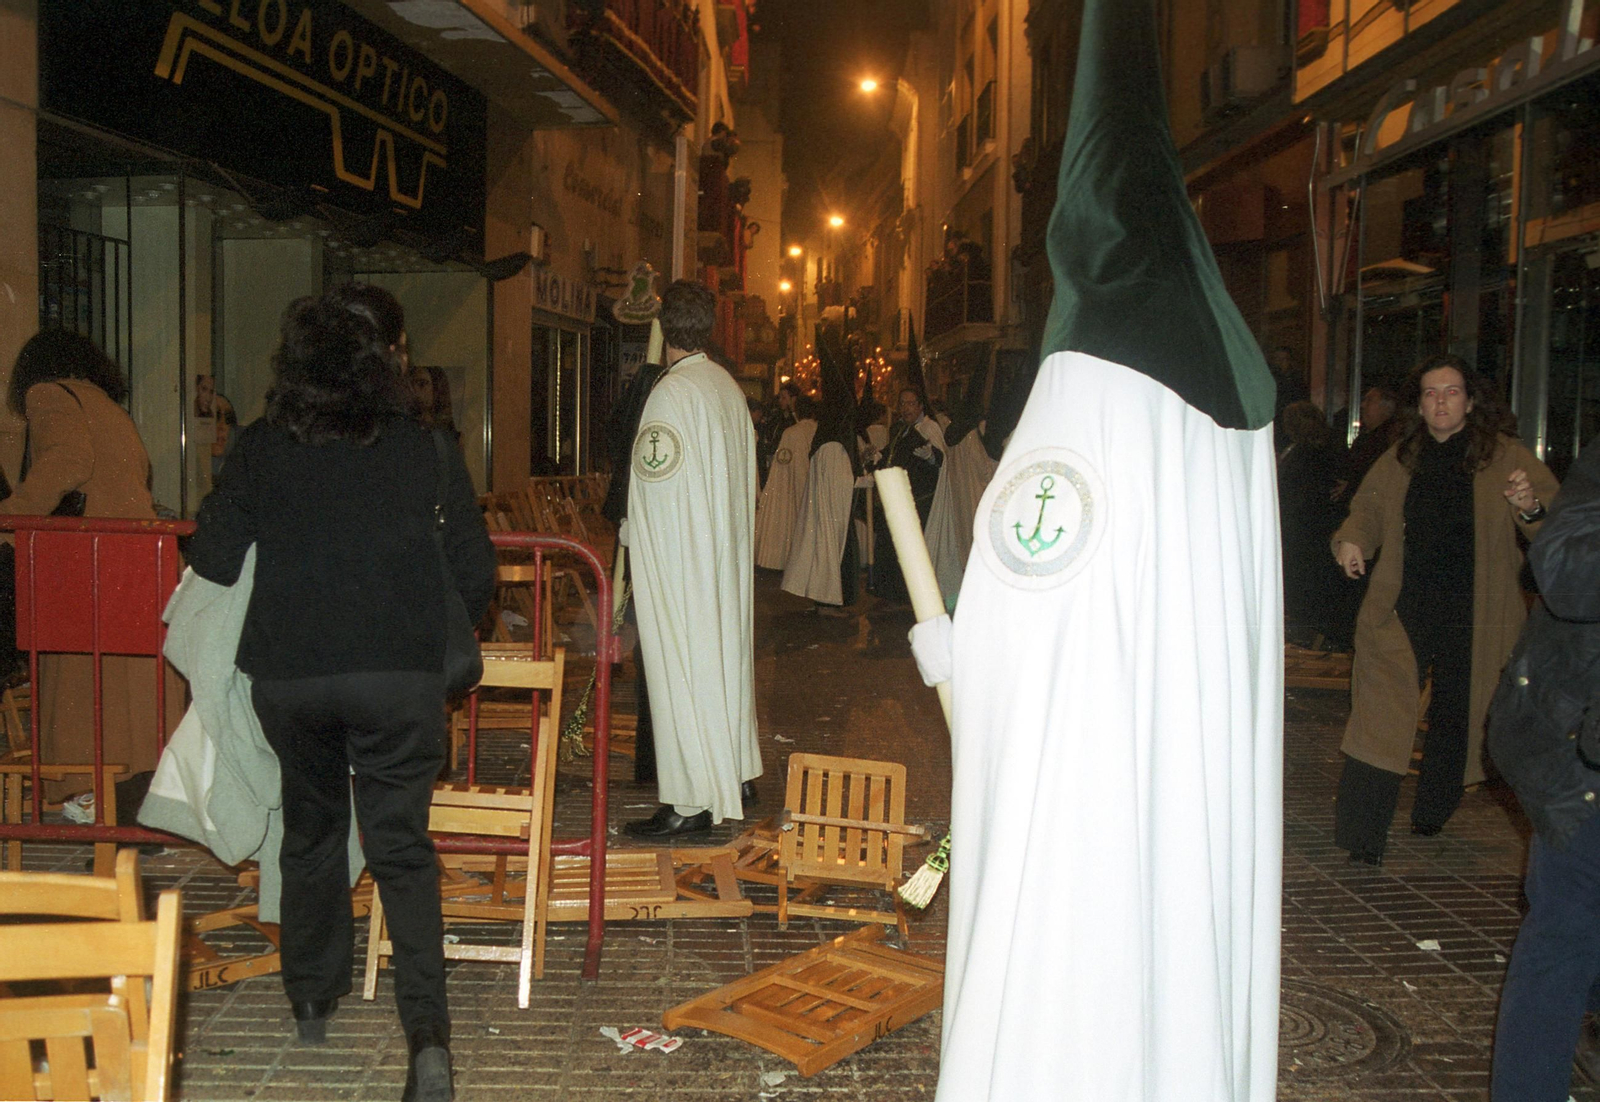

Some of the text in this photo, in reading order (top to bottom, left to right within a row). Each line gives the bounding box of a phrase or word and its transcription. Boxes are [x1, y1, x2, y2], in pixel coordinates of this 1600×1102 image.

[197, 0, 449, 134] LOA OPTICO
[193, 966, 229, 990] JLC
[871, 1015, 893, 1042] JLC
